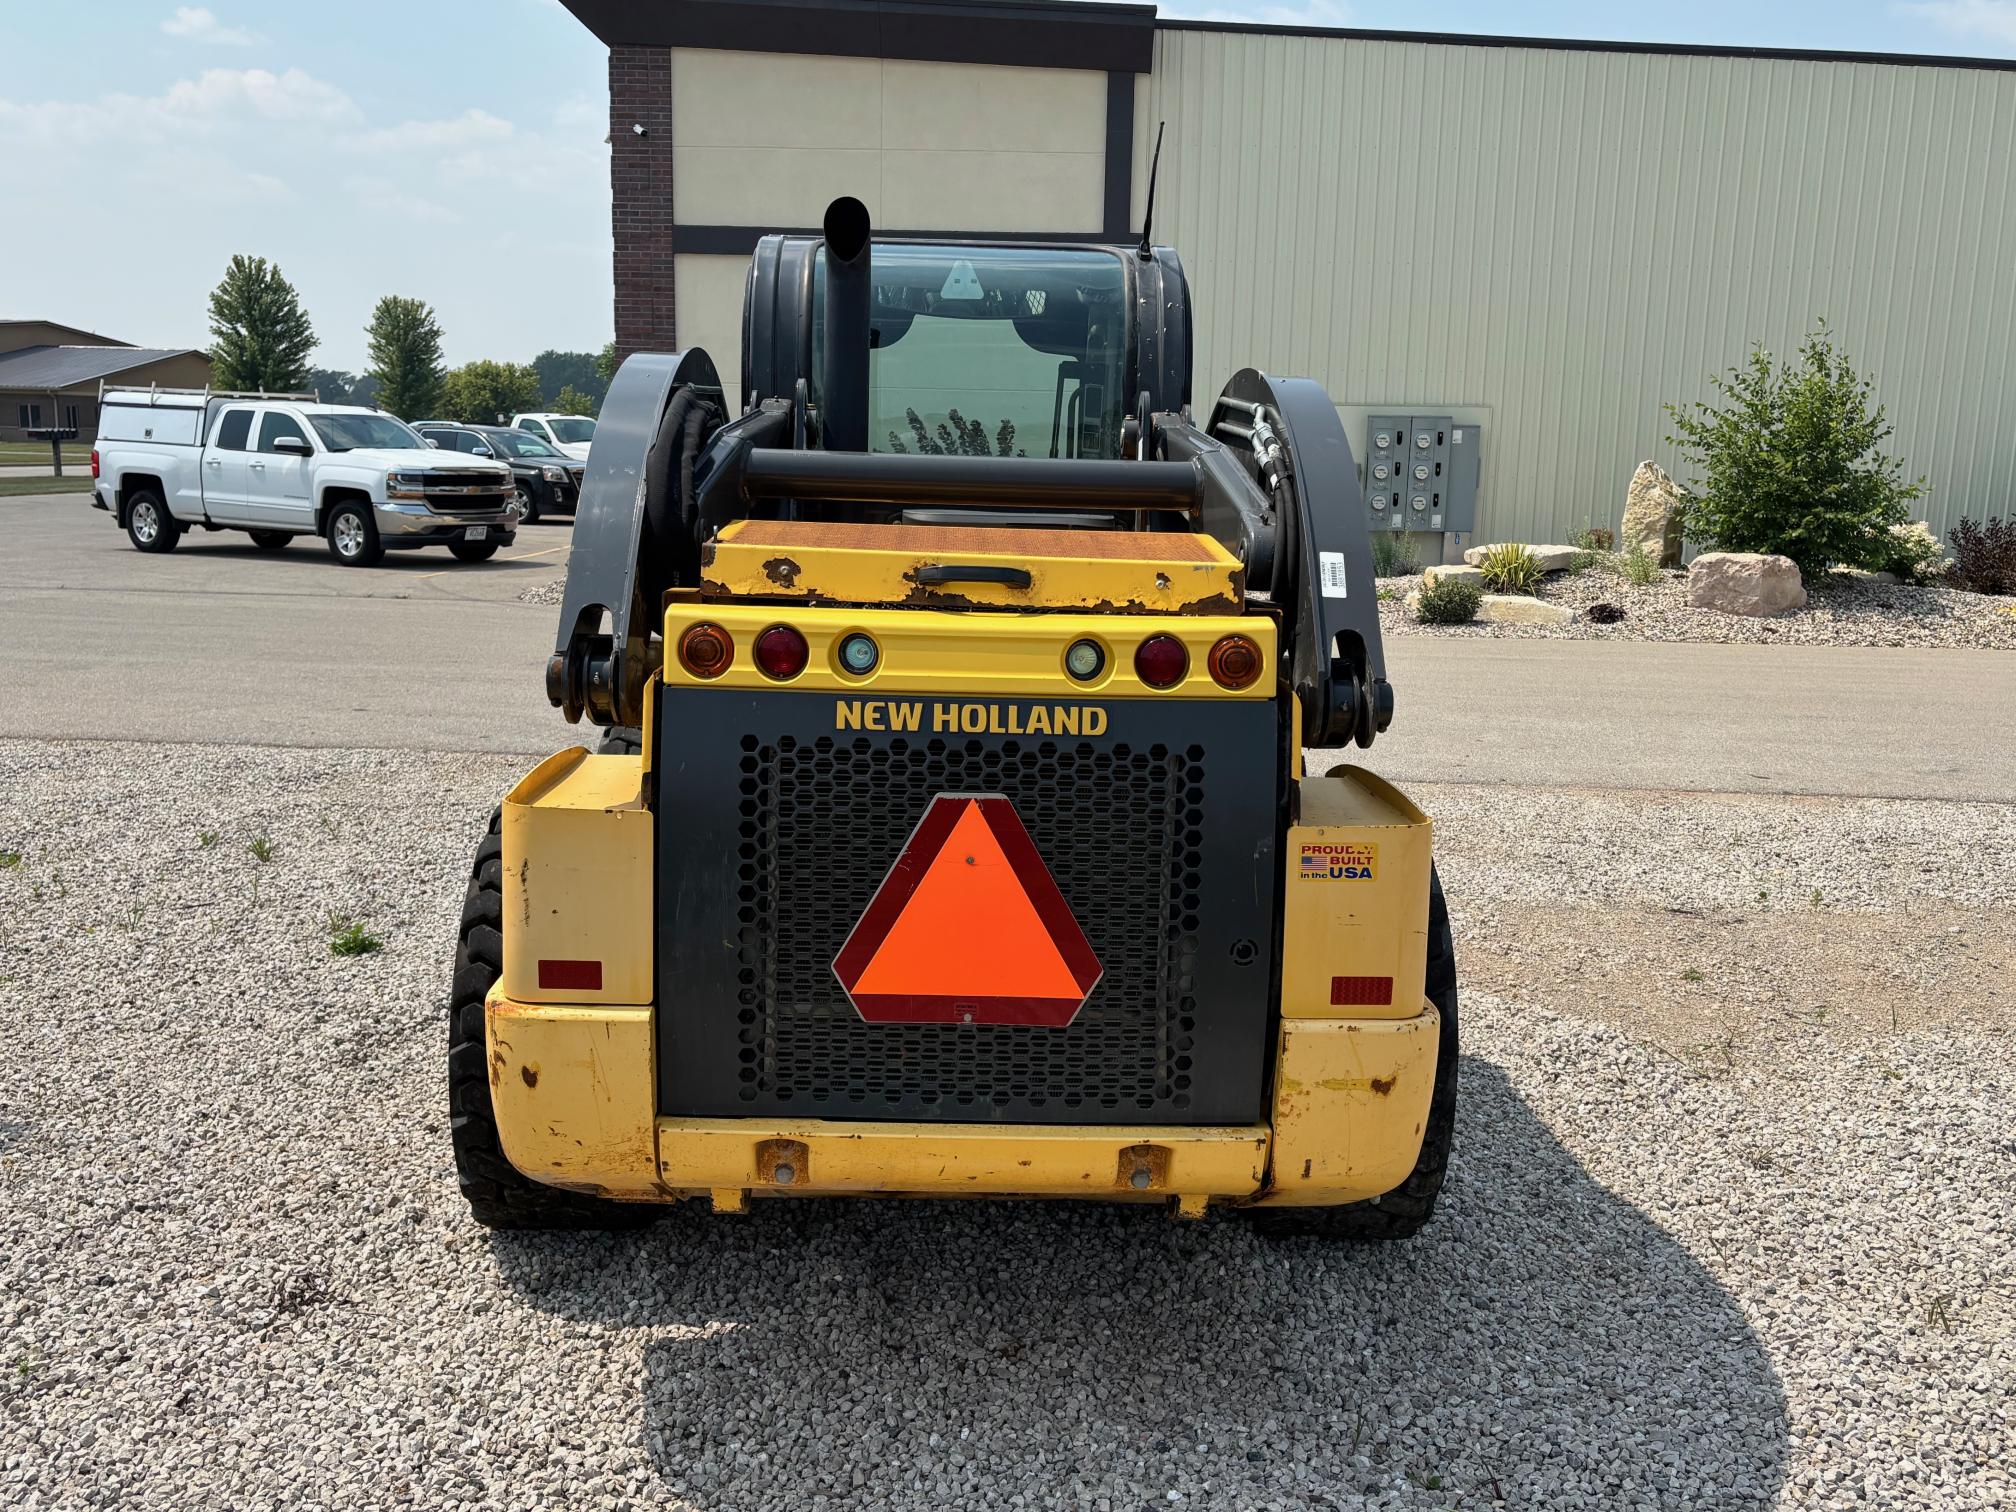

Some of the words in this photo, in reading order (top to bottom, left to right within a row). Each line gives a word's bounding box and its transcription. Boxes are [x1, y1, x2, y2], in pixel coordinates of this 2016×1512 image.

[836, 700, 923, 731] NEW
[933, 703, 1108, 736] HOLLAND
[1301, 846, 1373, 854] PROUD
[1330, 857, 1373, 865] BUILT
[1329, 867, 1372, 879] USA
